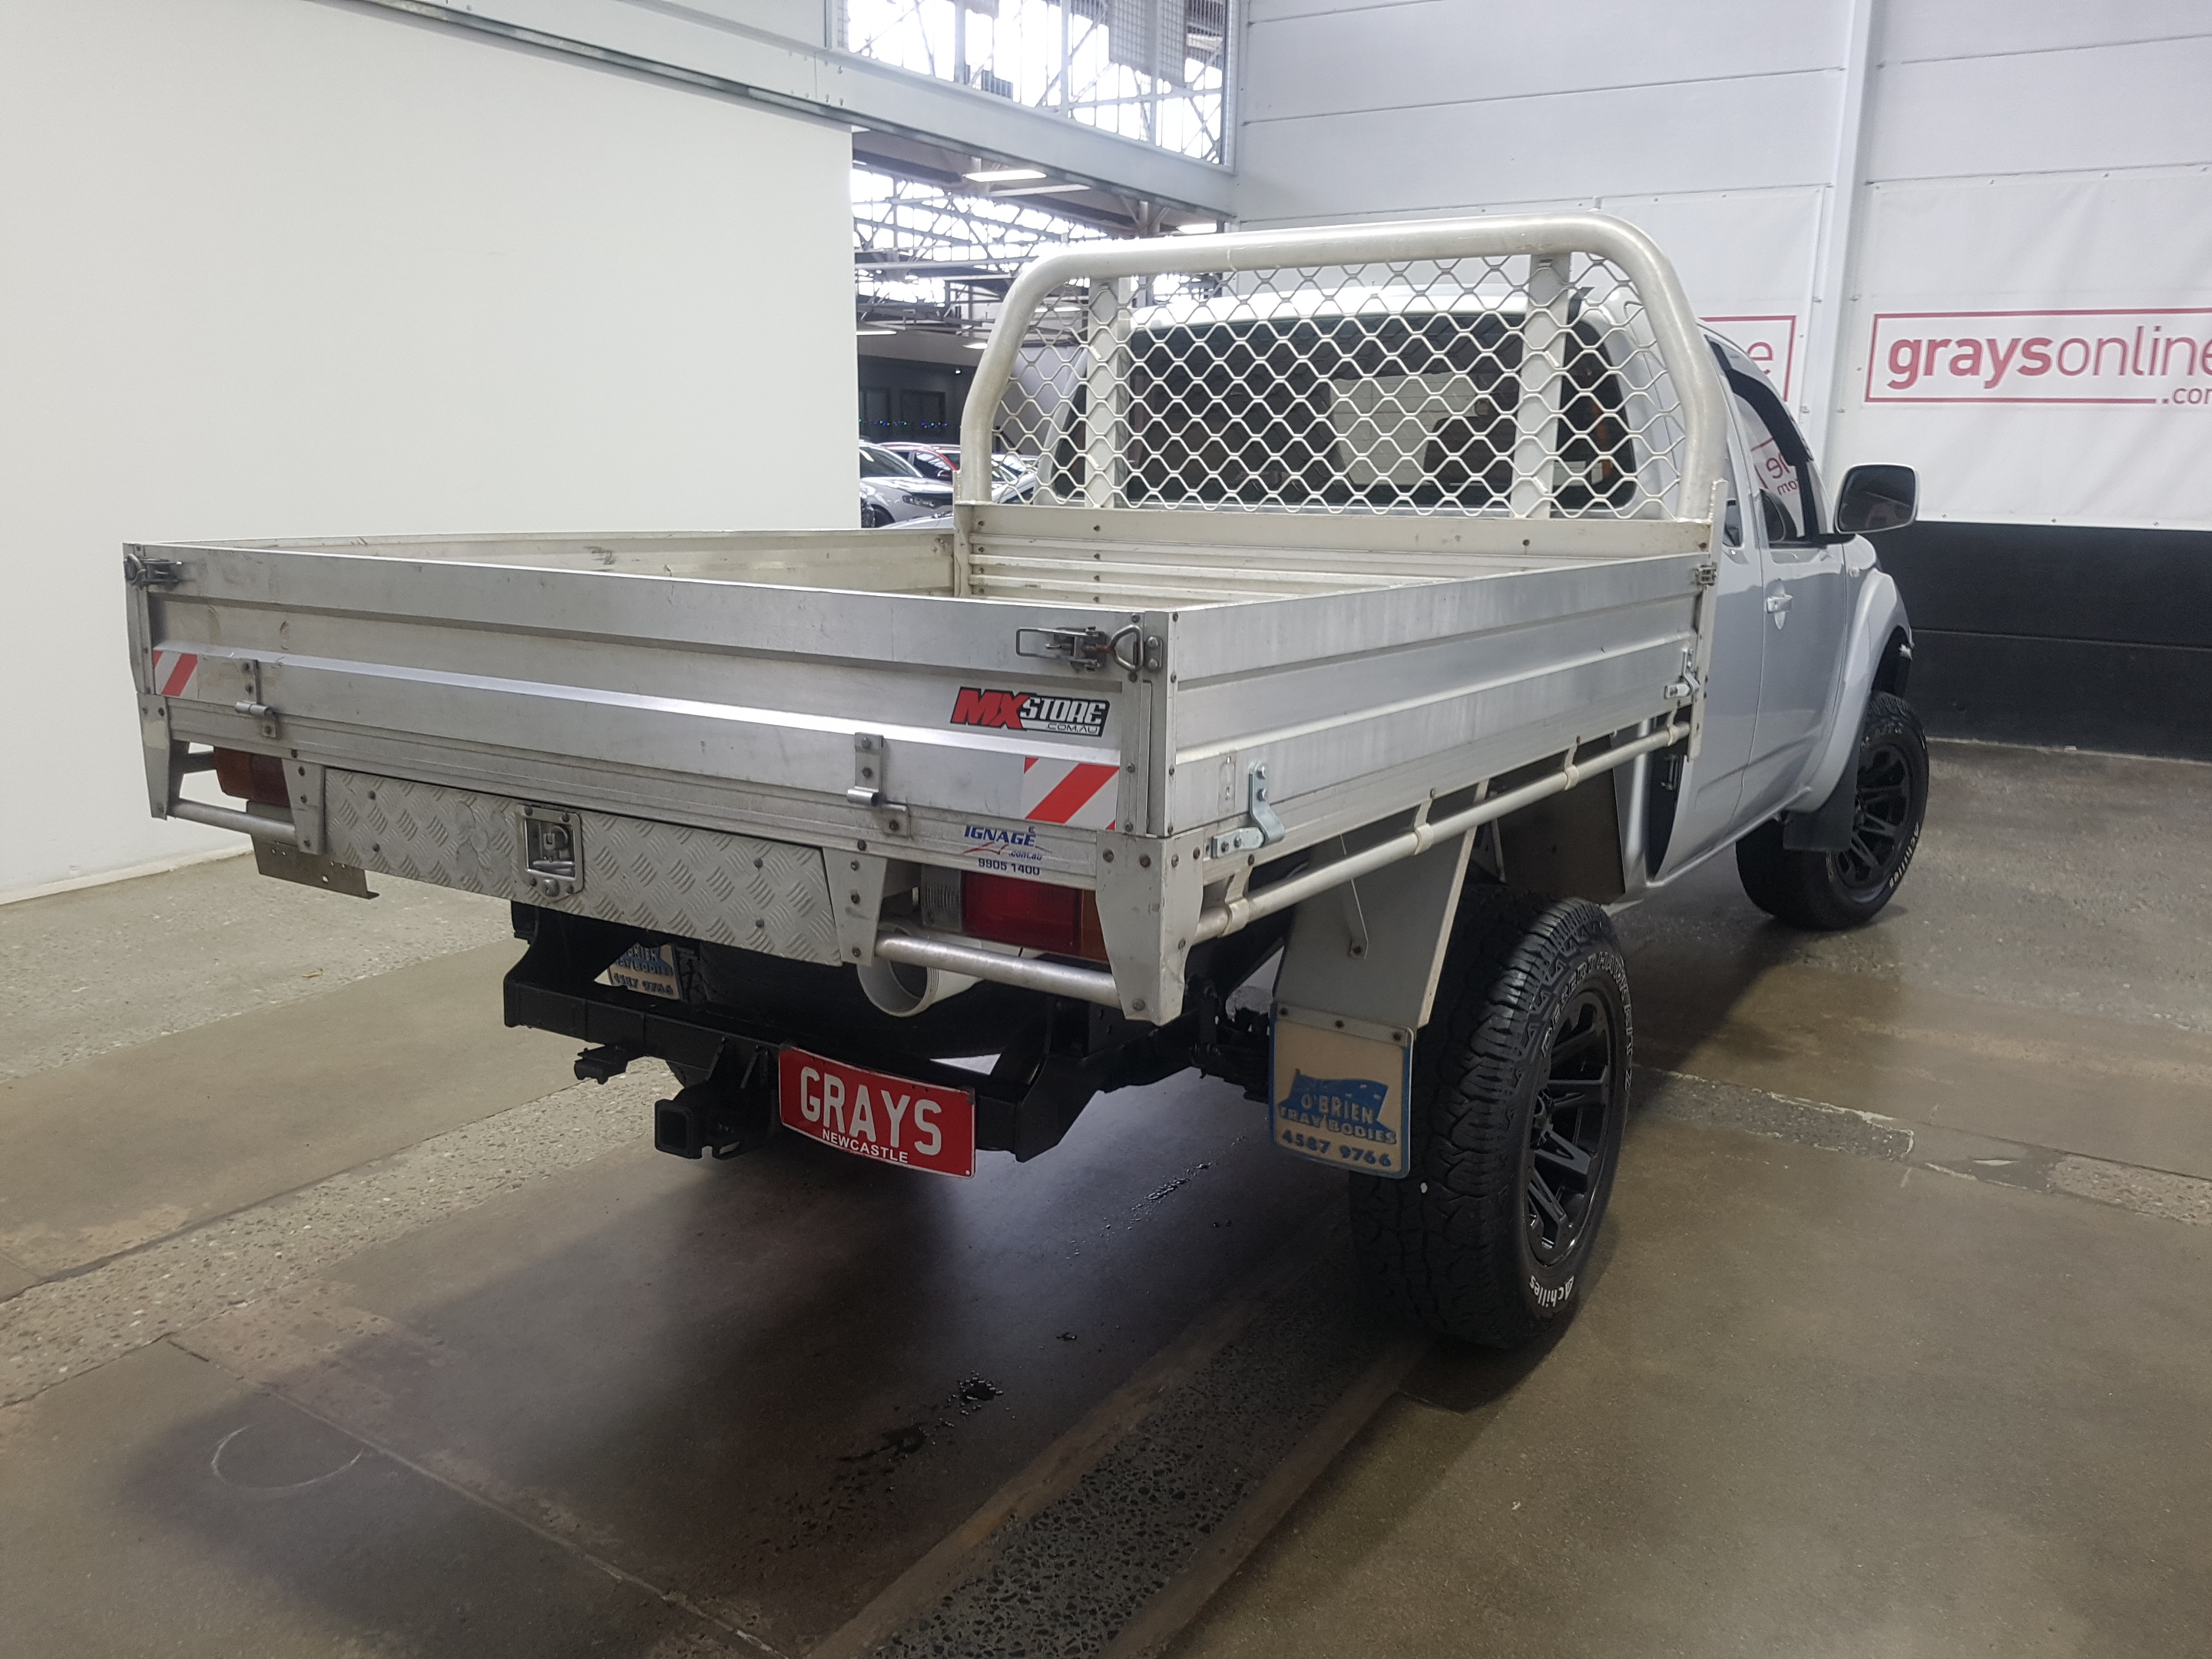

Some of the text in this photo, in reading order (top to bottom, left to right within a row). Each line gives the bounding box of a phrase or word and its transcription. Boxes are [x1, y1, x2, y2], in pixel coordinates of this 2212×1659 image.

[978, 858, 1040, 876] 9905 1400
[800, 1066, 942, 1156] GRAYS
[822, 1128, 909, 1164] NEWCASTLE
[1327, 1118, 1397, 1145] BODIES
[1529, 1275, 1575, 1308] Achilles
